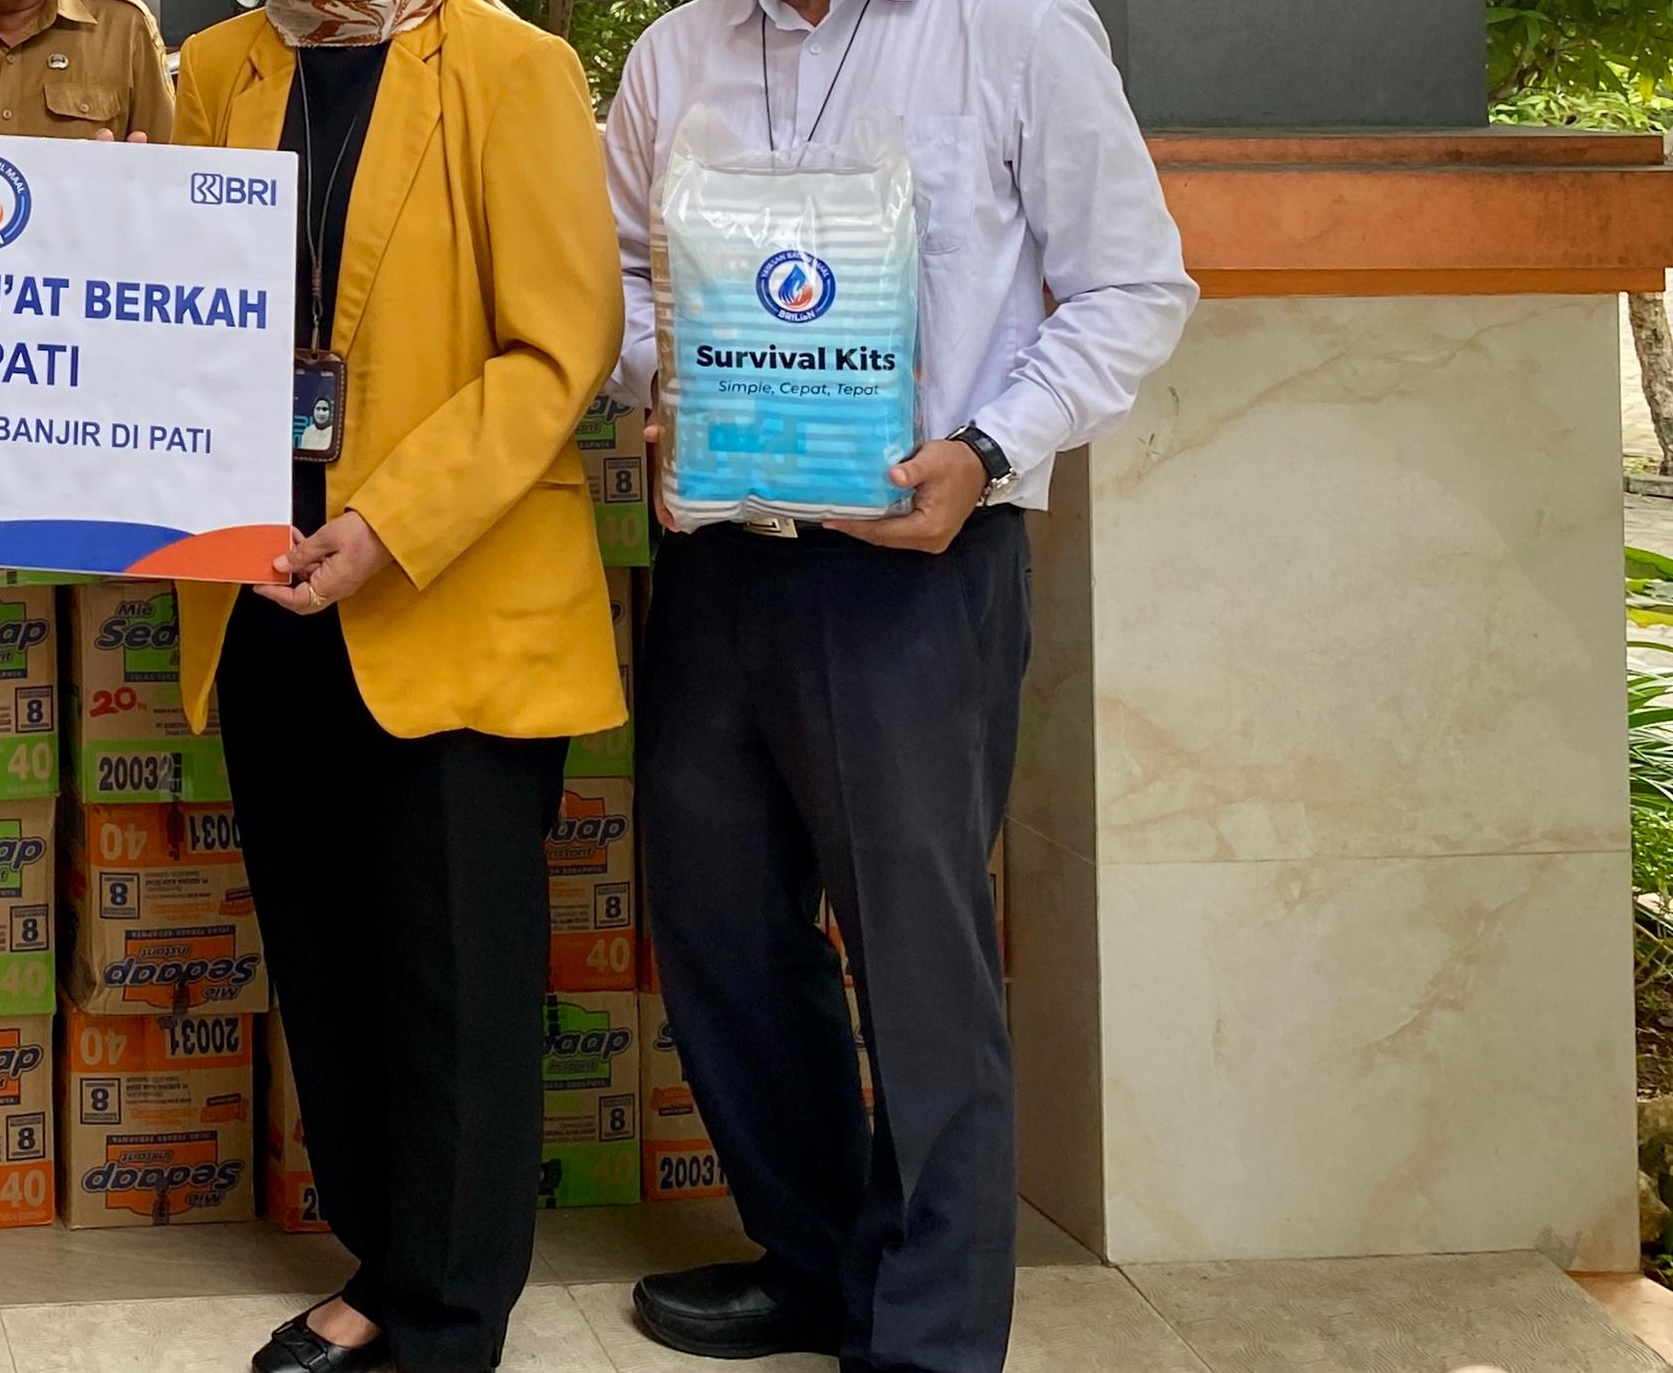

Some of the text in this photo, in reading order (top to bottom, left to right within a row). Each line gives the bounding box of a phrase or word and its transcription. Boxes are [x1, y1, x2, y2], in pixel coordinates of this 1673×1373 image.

[5, 167, 25, 194] MAAL
[225, 176, 277, 207] BRI
[84, 279, 267, 330] BERKAH
[696, 344, 895, 371] Survival Kits
[718, 380, 879, 397] Simple, Cepat, Tepat
[111, 423, 139, 449] DI
[149, 425, 212, 454] PATI
[616, 470, 632, 493] 8
[117, 601, 154, 618] Mie
[95, 615, 180, 650] Sed
[27, 699, 43, 723] 8
[7, 742, 54, 780] 40
[100, 823, 148, 861] 40
[110, 883, 128, 906] 8
[605, 896, 621, 918] 8
[22, 919, 38, 942] 8
[586, 937, 631, 974] 40
[0, 961, 47, 998] 40
[104, 952, 261, 987] Sedaap
[203, 984, 240, 1001] Mie
[80, 1026, 128, 1066] 40
[168, 1017, 240, 1056] 20031
[91, 1088, 109, 1111] 8
[610, 1108, 626, 1131] 8
[18, 1127, 35, 1150] 8
[0, 1169, 46, 1208] 40
[82, 1159, 245, 1194] Sedaap
[186, 1191, 223, 1206] Mie
